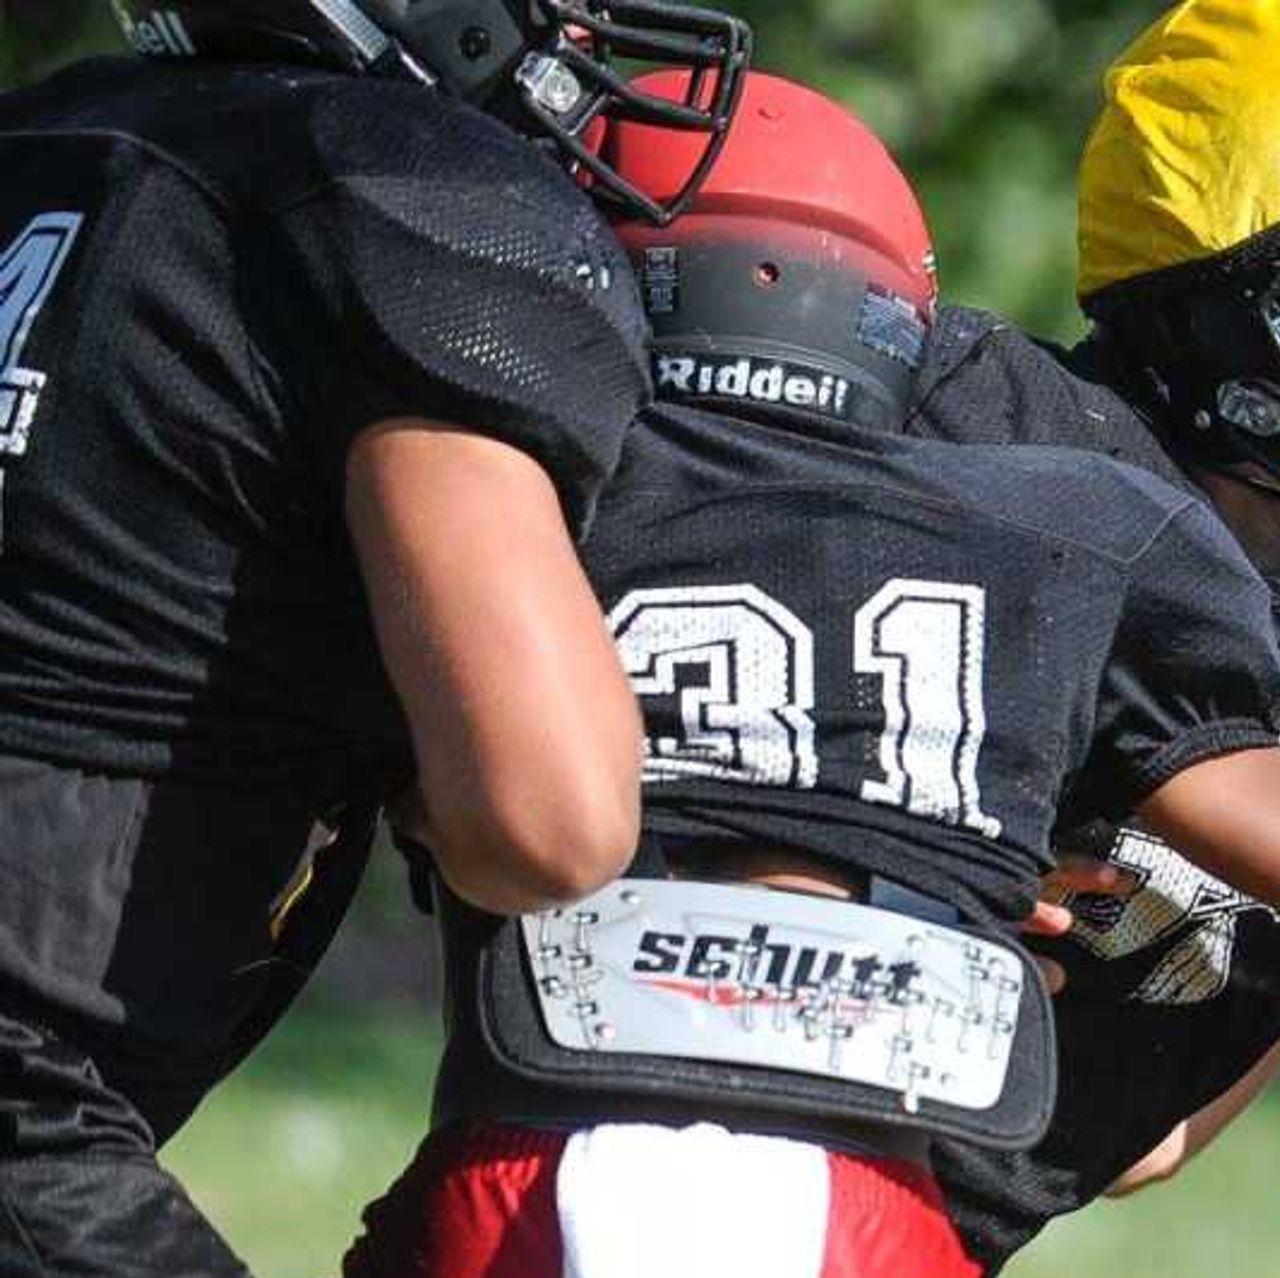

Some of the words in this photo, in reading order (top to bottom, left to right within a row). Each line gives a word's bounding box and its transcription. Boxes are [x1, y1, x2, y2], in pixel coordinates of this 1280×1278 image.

[656, 355, 849, 411] Riddell
[606, 578, 1001, 839] 31
[633, 924, 922, 1007] schutt
